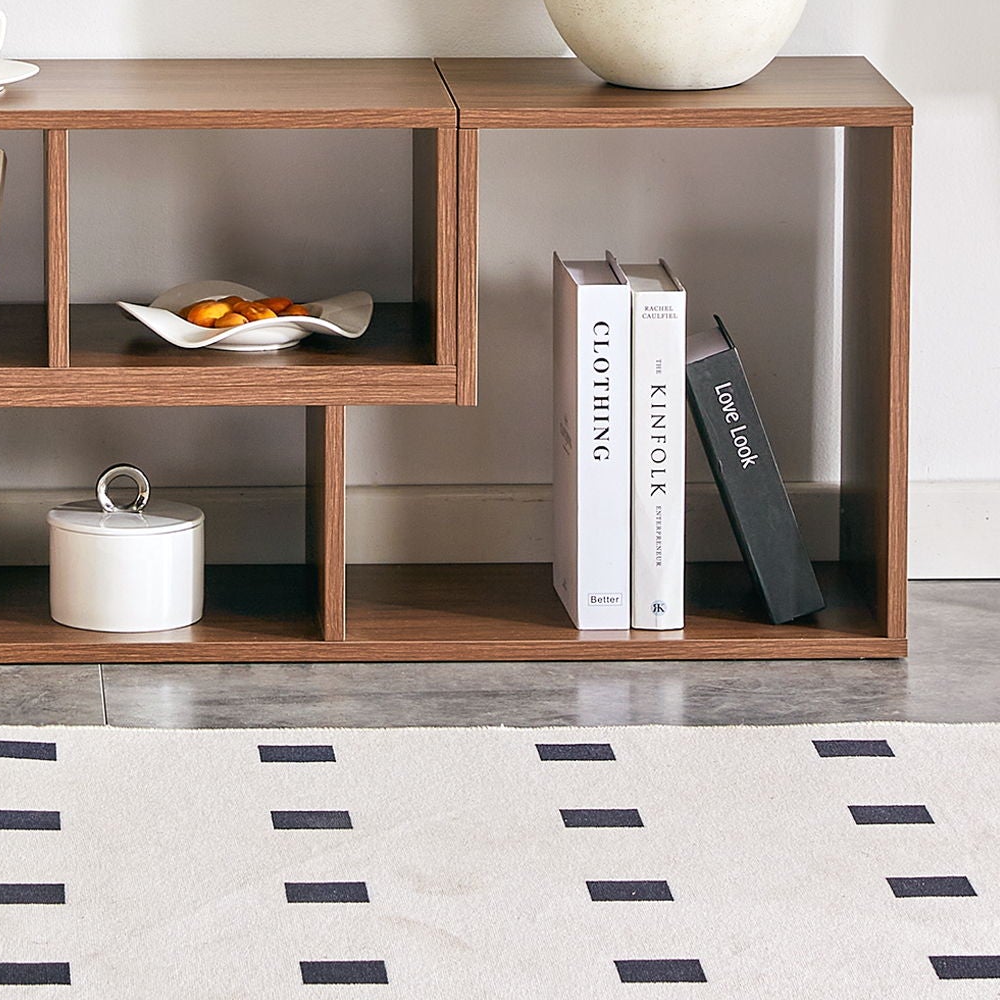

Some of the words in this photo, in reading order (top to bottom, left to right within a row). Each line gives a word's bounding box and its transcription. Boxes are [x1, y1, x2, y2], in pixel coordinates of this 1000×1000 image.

[592, 320, 610, 462] CLOTHING
[650, 384, 667, 497] KINFOLK
[713, 381, 740, 424] Love
[729, 424, 759, 470] Look
[590, 595, 620, 604] Better
